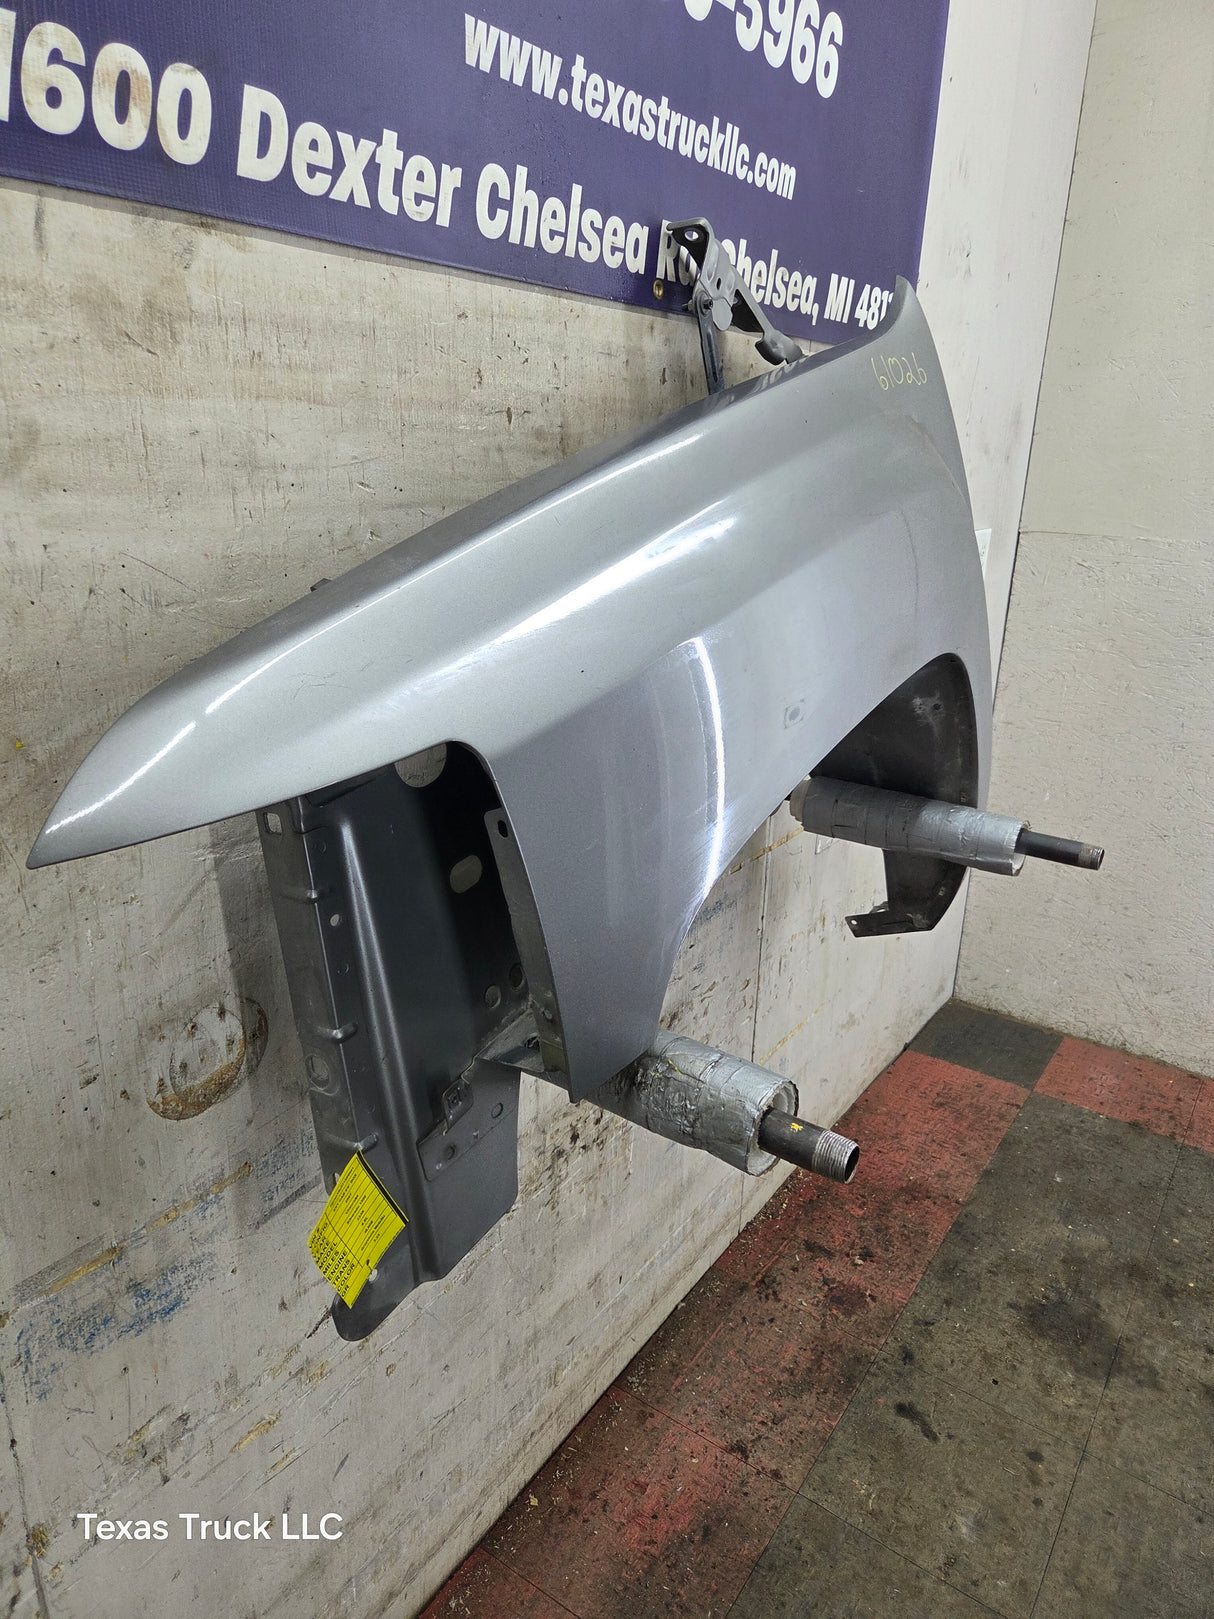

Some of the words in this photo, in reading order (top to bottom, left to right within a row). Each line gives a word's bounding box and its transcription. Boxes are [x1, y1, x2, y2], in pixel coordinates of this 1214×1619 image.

[684, 0, 843, 98] -3966
[465, 13, 796, 200] www.texastruckllc.com
[237, 84, 462, 227] Dexter
[476, 163, 649, 274] Chelsea
[824, 273, 855, 324] MI
[871, 352, 927, 390] 61026
[319, 1242, 337, 1269] MODEL
[323, 1250, 339, 1275] MILES
[327, 1250, 347, 1281] ENGINE
[332, 1259, 350, 1286] TRANS
[338, 1263, 355, 1292] COLOR
